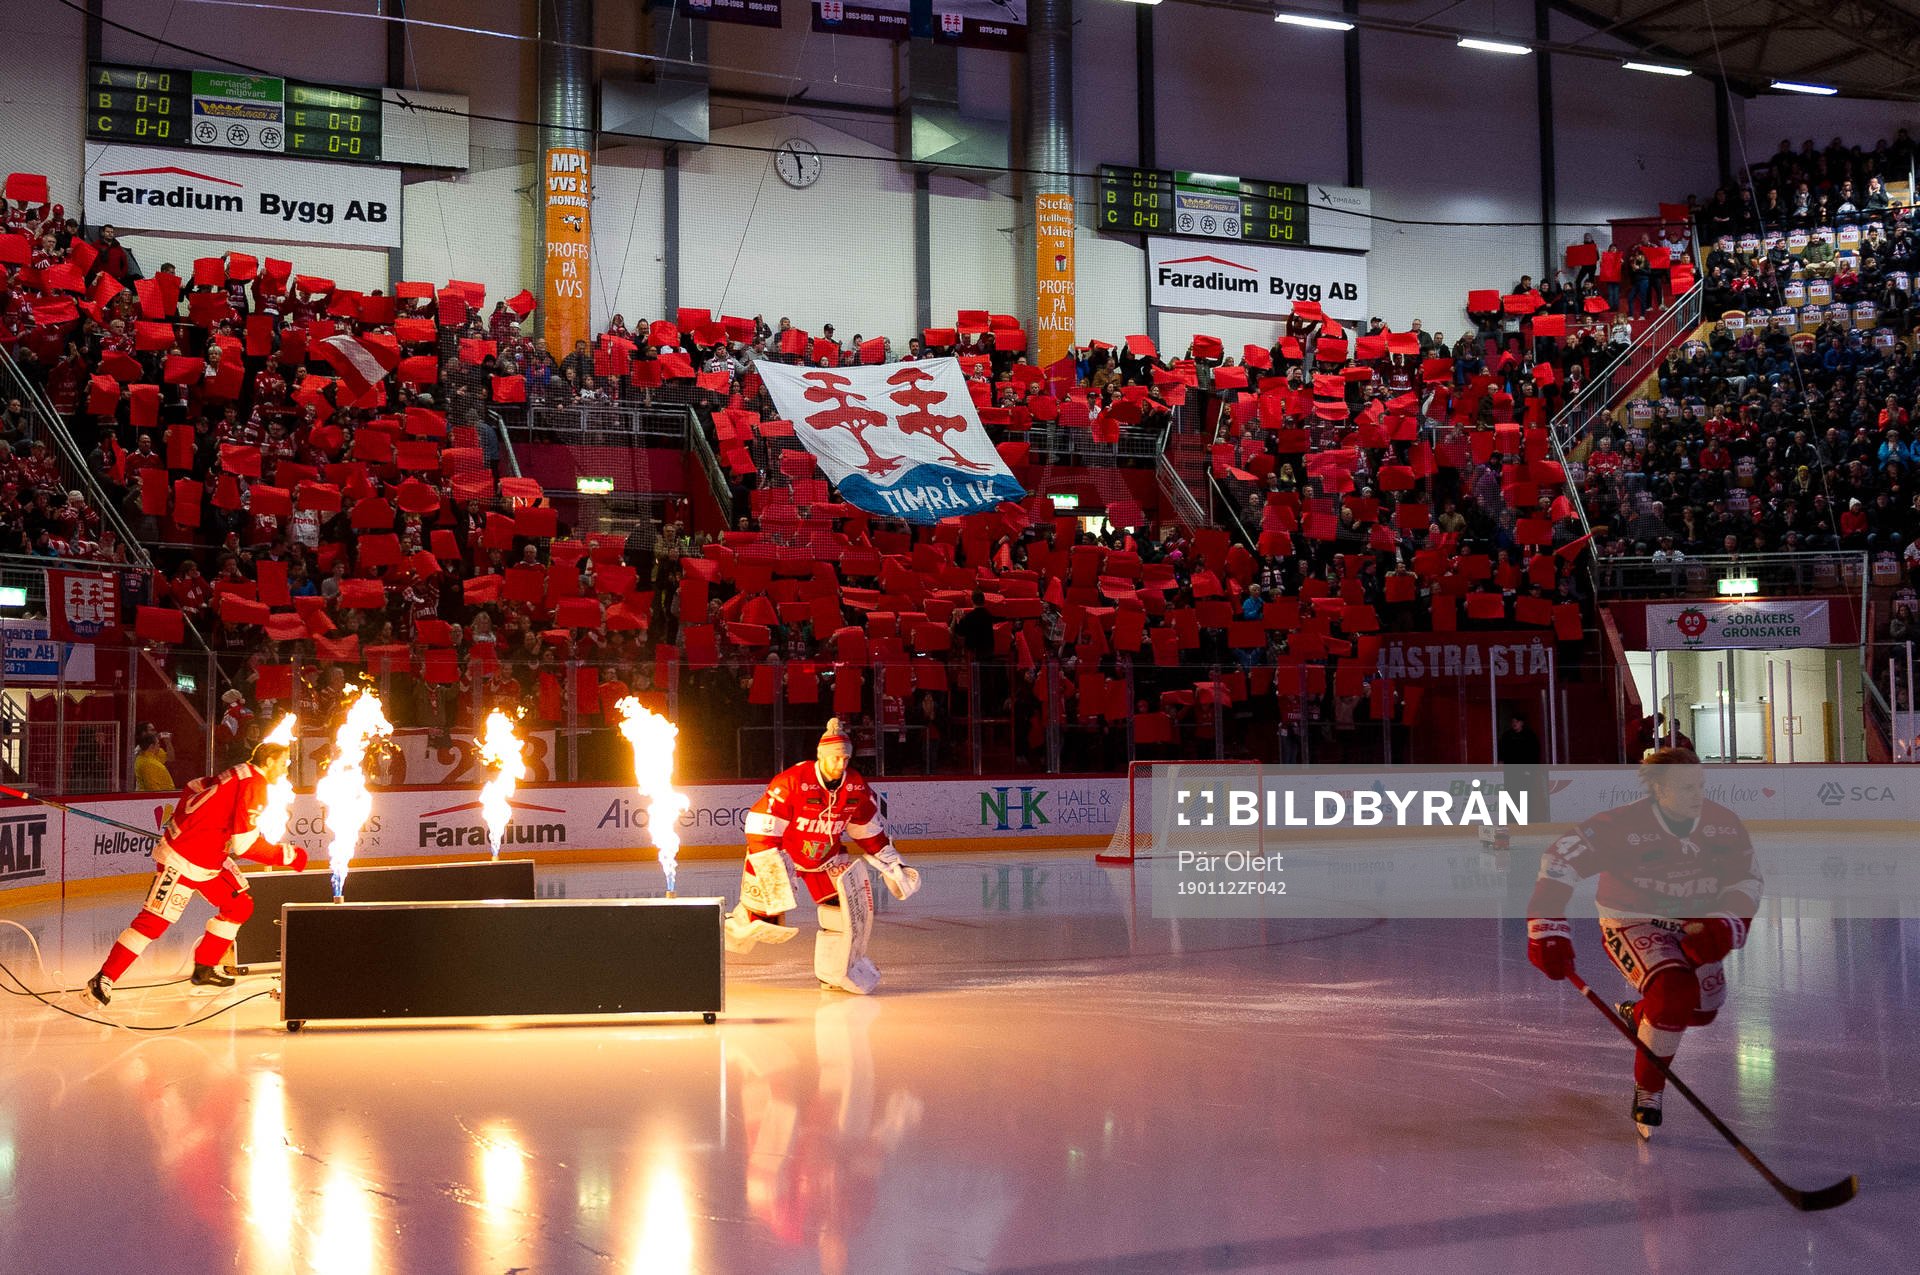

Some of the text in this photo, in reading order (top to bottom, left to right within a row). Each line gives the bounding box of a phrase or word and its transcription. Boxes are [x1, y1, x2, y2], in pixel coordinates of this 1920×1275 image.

[100, 71, 112, 86] A
[99, 93, 112, 108] B
[98, 116, 112, 131] C
[295, 111, 306, 126] E
[294, 133, 305, 148] F
[549, 177, 577, 192] VVS
[99, 180, 387, 224] Faradium Bygg AB
[549, 195, 589, 208] MONTAGE
[1039, 198, 1073, 211] Stefan
[1107, 191, 1117, 203] B
[1107, 210, 1118, 223] C
[1244, 204, 1253, 216] E
[1244, 223, 1253, 235] F
[548, 242, 588, 260] PROFFS
[562, 260, 577, 278] PÅ
[555, 279, 583, 298] VVS
[1039, 280, 1074, 296] PROFFS
[1159, 268, 1358, 301] Faradium Bygg AB
[1053, 295, 1066, 312] PÅ
[877, 476, 1004, 519] TIMRÅ IK
[1727, 612, 1795, 625] SÖRÅKERS
[1721, 624, 1801, 638] GRÖNSAKER
[1493, 636, 1548, 676] STÅ
[1731, 784, 1759, 802] love
[1851, 786, 1895, 801] SCA
[980, 786, 1111, 831] NHK HALL &
[1058, 807, 1112, 824] KAPELL
[888, 823, 929, 836] INVEST
[1718, 827, 1737, 835] SCA
[1642, 834, 1661, 842] SCA
[1633, 877, 1718, 897] TIMR
